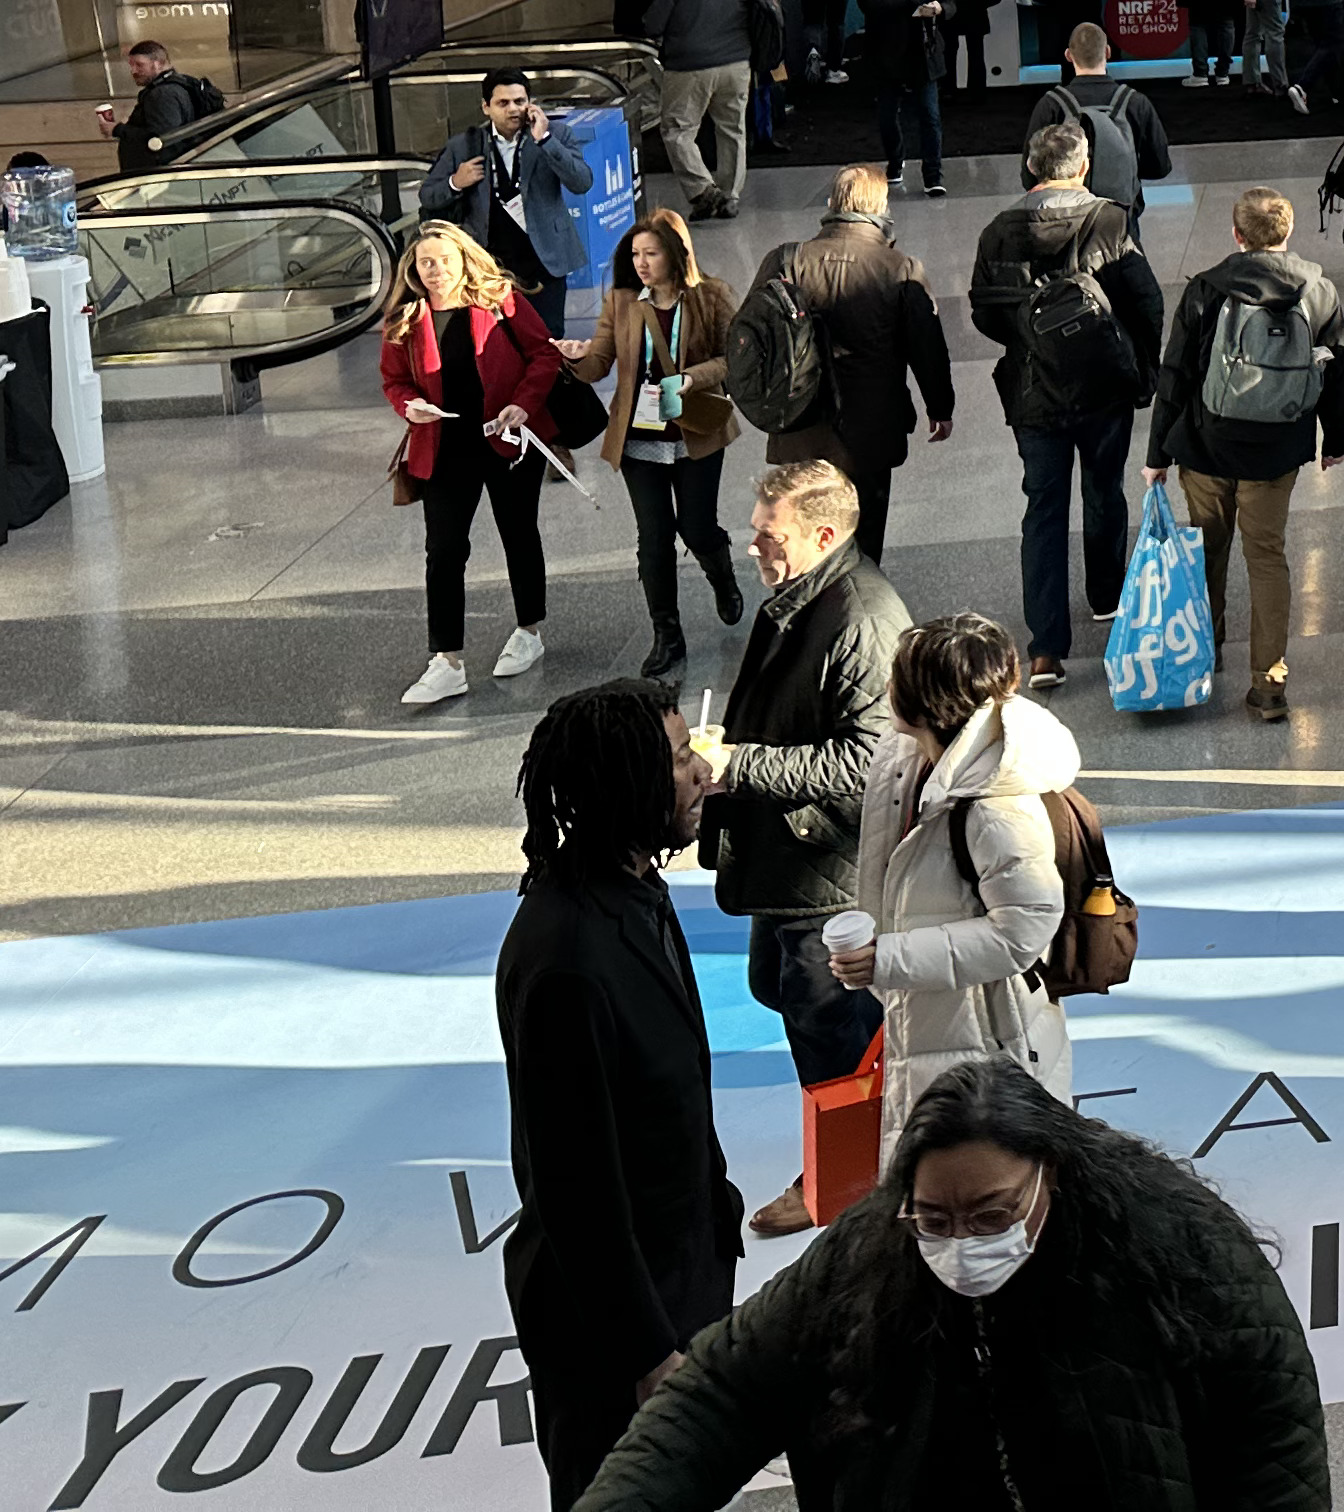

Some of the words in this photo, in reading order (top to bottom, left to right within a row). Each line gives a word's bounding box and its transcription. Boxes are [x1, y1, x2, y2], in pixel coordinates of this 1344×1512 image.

[1118, 14, 1179, 25] RETAIL'S
[1119, 25, 1140, 35] BIG
[1142, 23, 1179, 34] SHOW
[48, 1334, 537, 1512] YOUR
